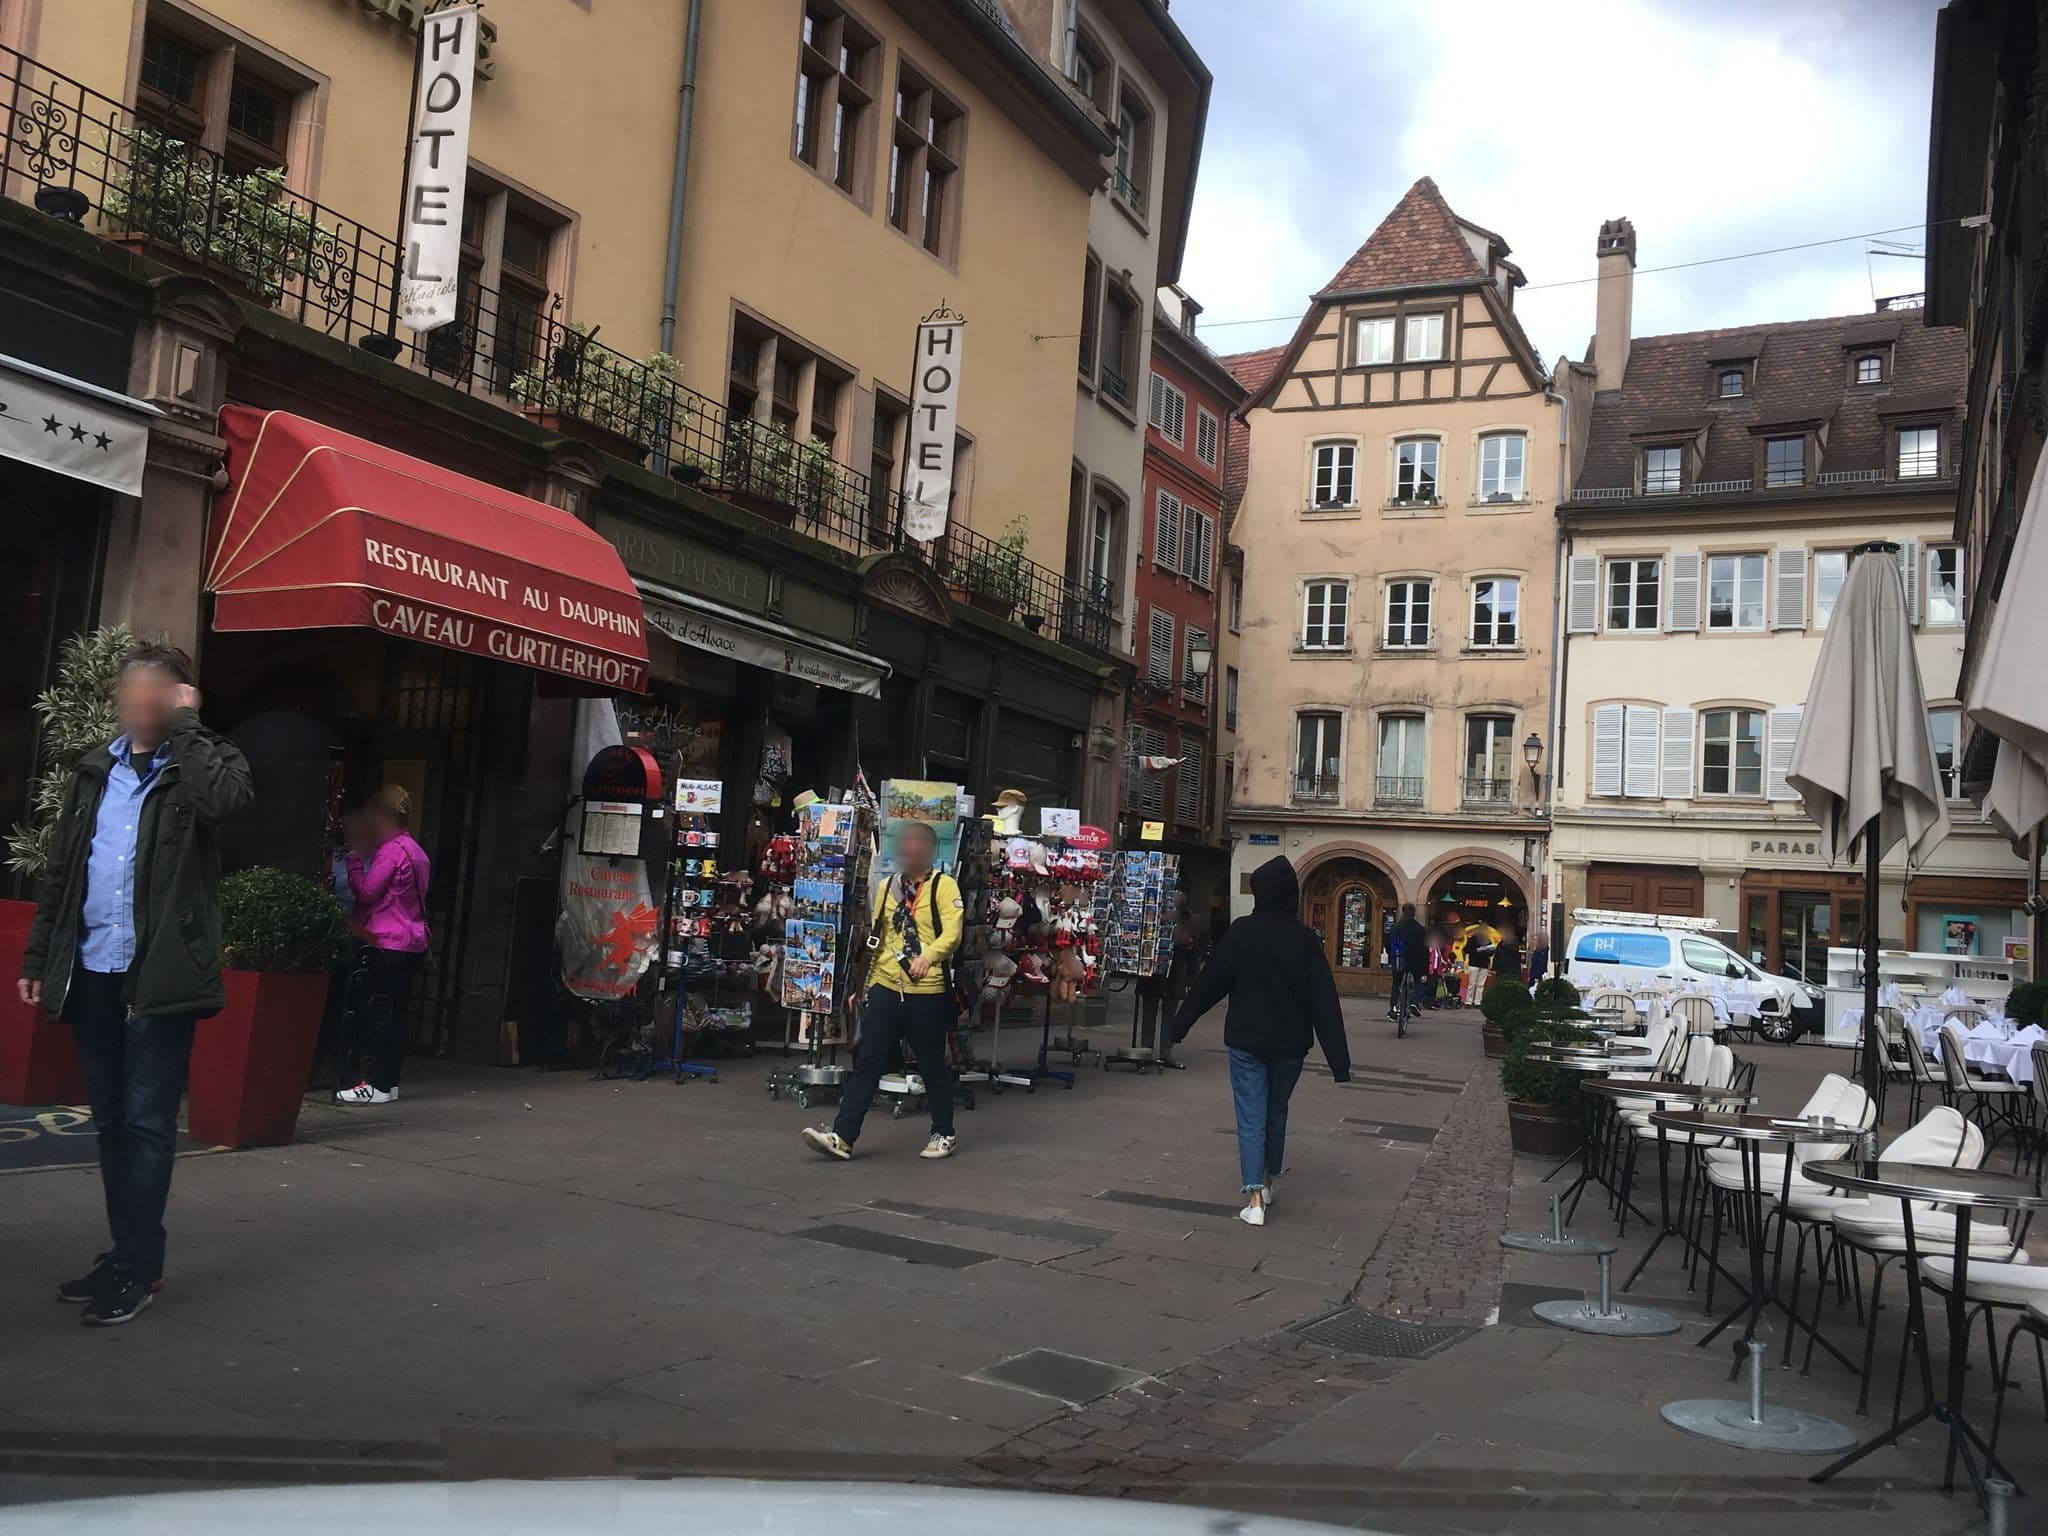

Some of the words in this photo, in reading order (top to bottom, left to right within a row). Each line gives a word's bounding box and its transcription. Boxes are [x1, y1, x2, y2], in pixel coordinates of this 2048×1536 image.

[408, 17, 463, 282] HOTEL
[914, 328, 953, 508] HOTEL
[365, 539, 509, 600] RESTAURANT
[523, 586, 549, 612] AU
[559, 597, 640, 638] DAUPHIN
[372, 600, 474, 647] CAVEAU
[487, 629, 643, 689] GURTLERHOFT
[650, 611, 676, 635] Arts
[678, 619, 736, 652] d'Alsace
[680, 782, 695, 790] MUG
[1751, 841, 1821, 855] PARAS
[568, 881, 634, 901] Restaurant
[1594, 936, 1615, 953] RH
